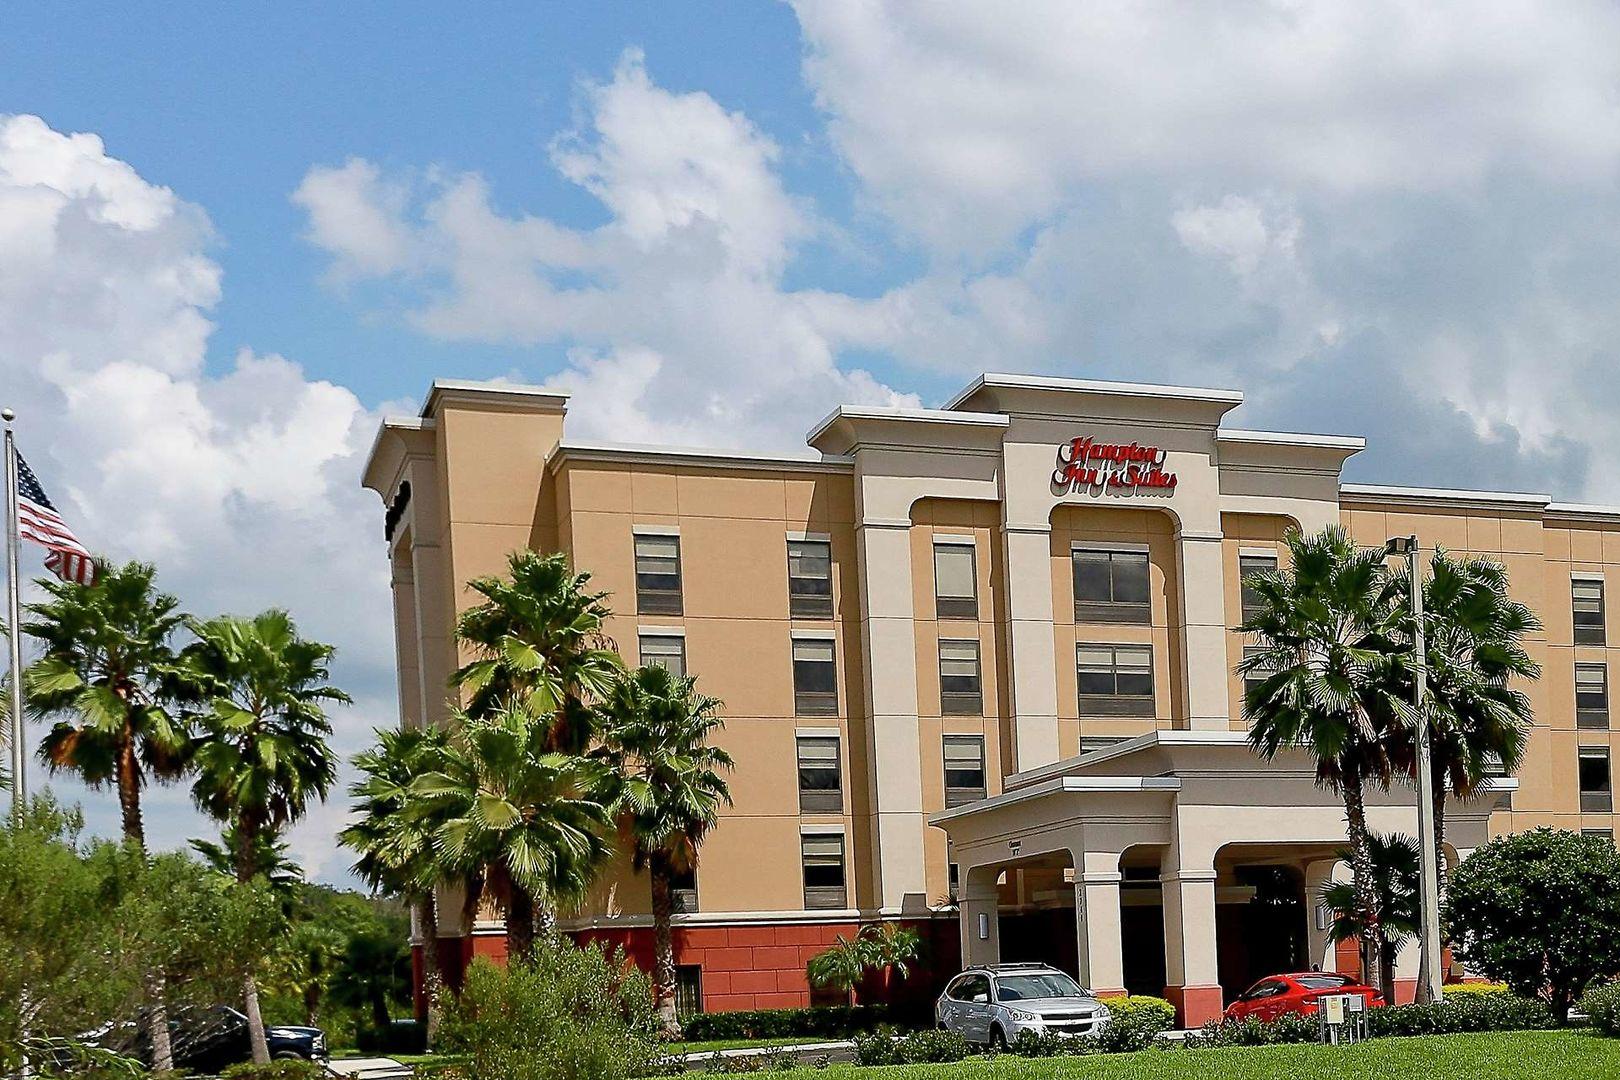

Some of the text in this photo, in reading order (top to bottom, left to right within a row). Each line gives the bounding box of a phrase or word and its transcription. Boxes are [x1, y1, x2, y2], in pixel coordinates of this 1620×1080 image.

[1058, 435, 1167, 465] Hampton
[1051, 463, 1178, 489] Inn & Suites
